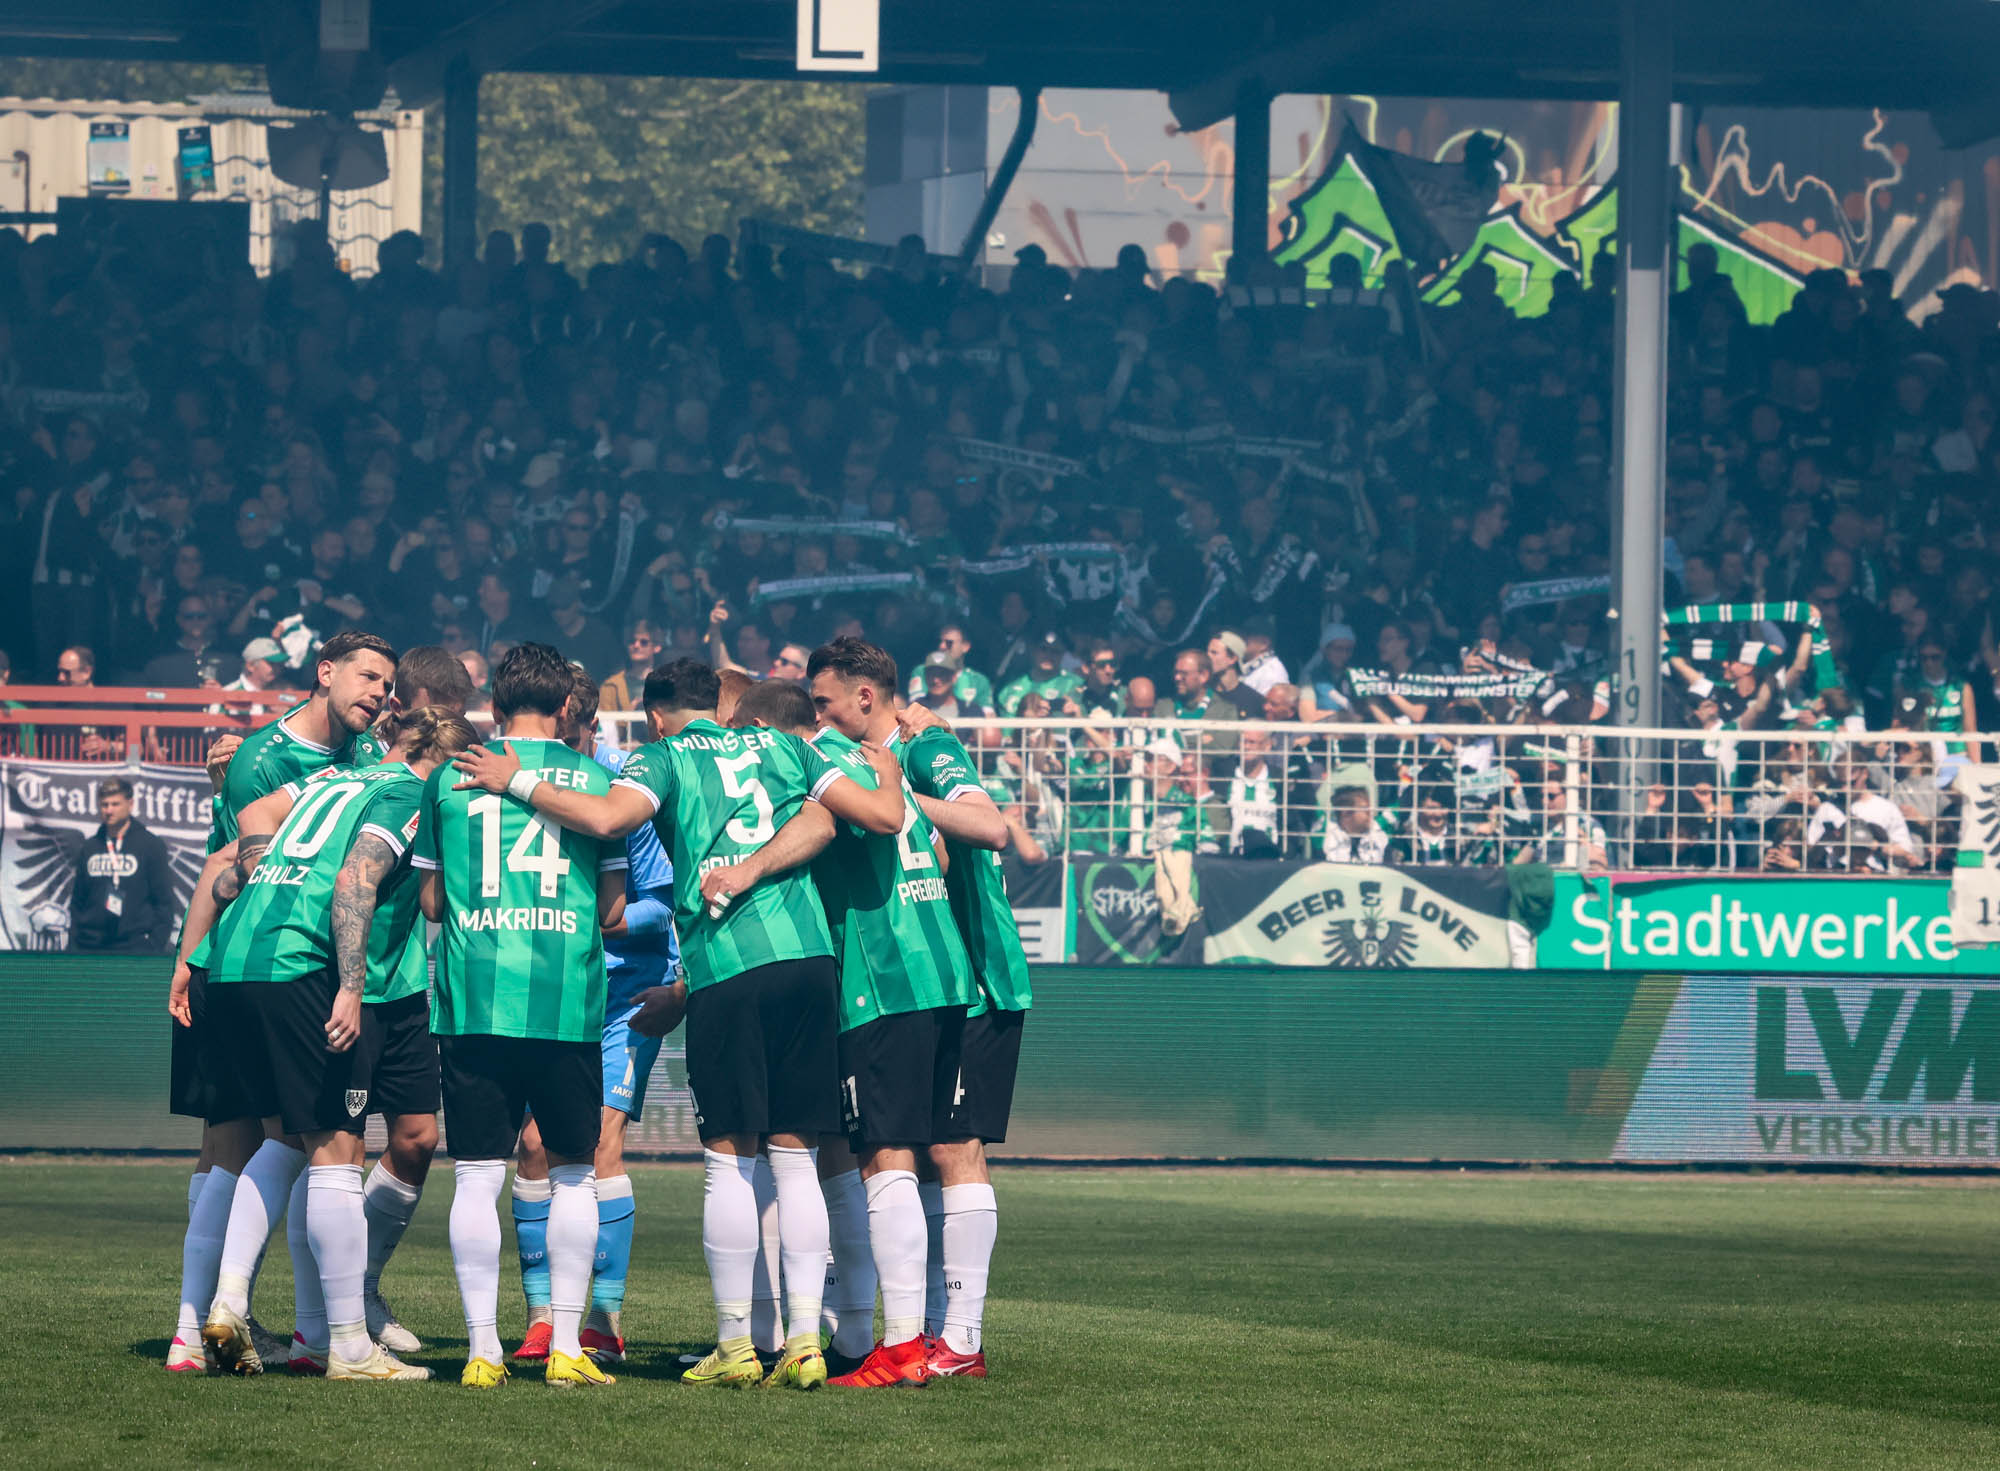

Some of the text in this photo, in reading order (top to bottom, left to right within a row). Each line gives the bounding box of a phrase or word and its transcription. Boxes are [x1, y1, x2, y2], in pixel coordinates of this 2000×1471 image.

[812, 0, 864, 59] L
[671, 731, 777, 752] MÜNSER
[263, 781, 365, 859] 10
[714, 750, 776, 844] 5
[248, 864, 311, 886] CHULZ
[468, 794, 570, 898] 14
[459, 908, 577, 934] MAKRIDIS
[1257, 889, 1346, 942] BEER
[1400, 886, 1479, 952] LOVE
[1571, 894, 1960, 961] Stadtwerke
[1755, 986, 2000, 1103] LVM
[611, 1085, 633, 1098] JAKO
[1755, 1114, 2000, 1156] VERSICHE
